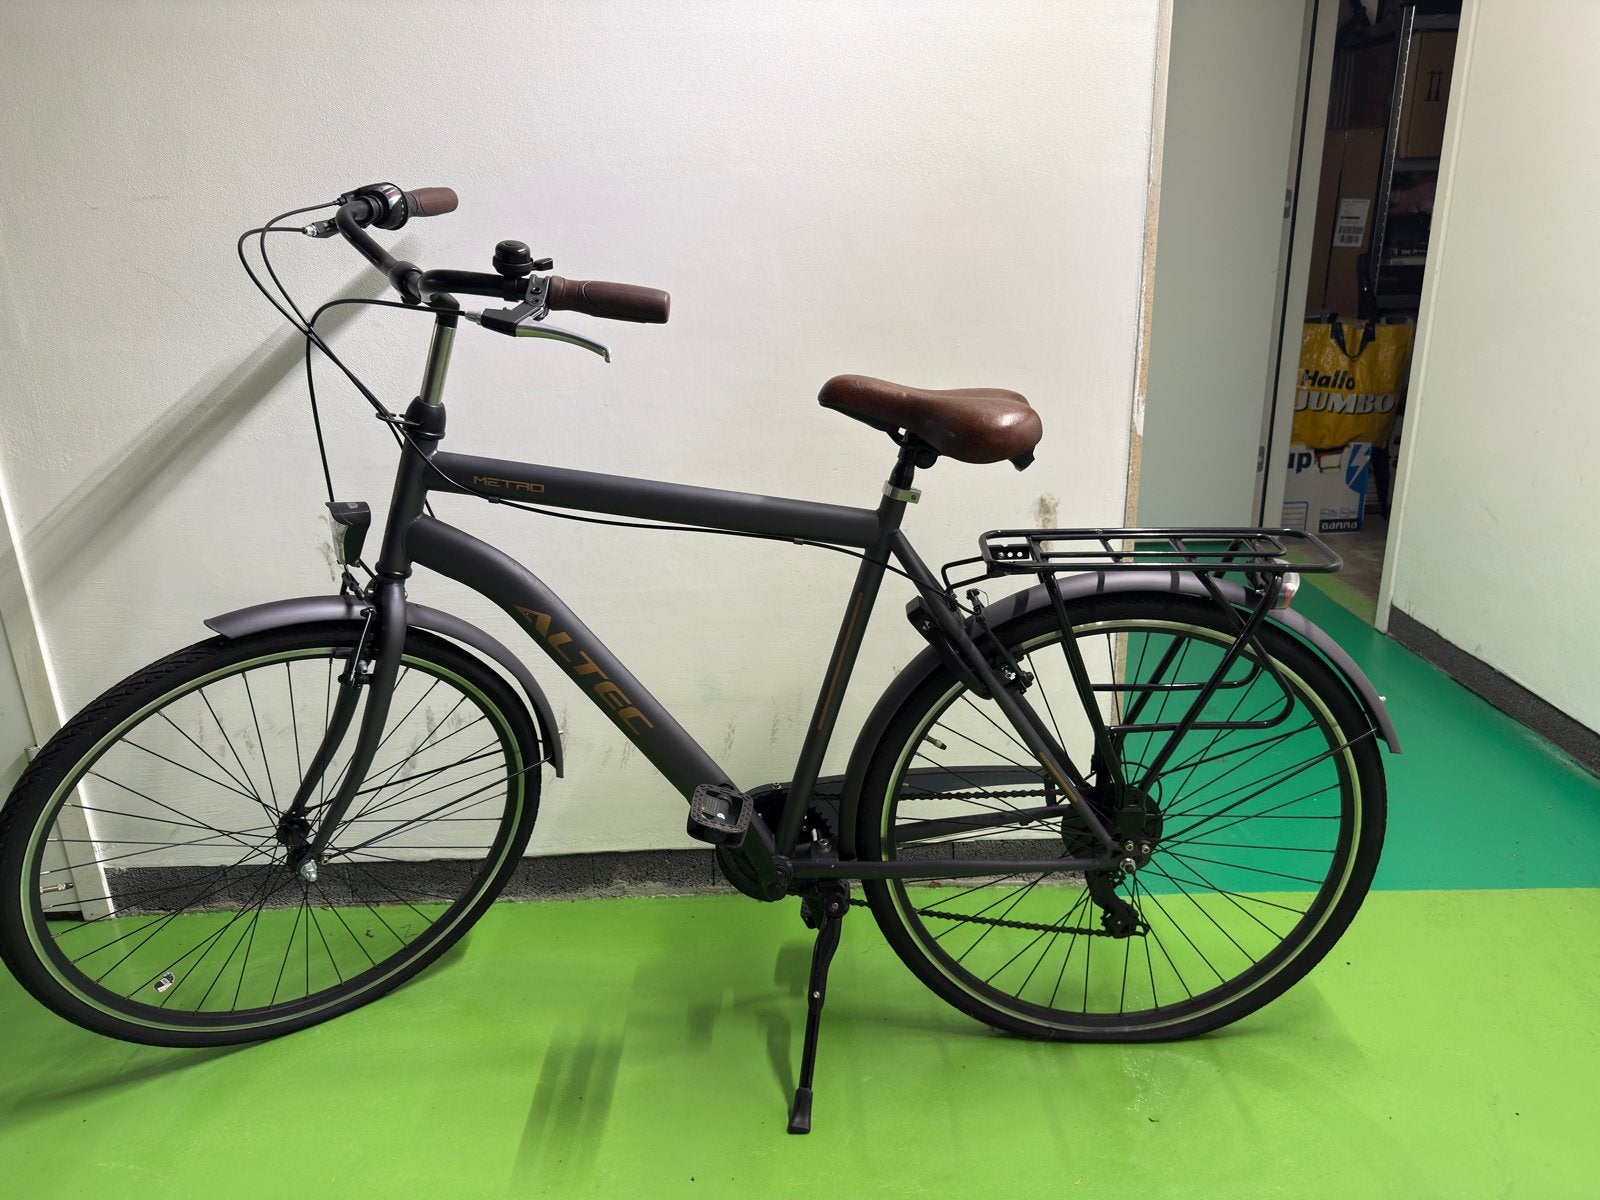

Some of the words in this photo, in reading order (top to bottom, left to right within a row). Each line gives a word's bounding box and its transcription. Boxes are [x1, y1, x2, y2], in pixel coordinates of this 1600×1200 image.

[1301, 369, 1355, 390] Hallo
[1295, 390, 1395, 414] JUMBO
[473, 475, 544, 493] METRO
[513, 604, 654, 736] ALTEC
